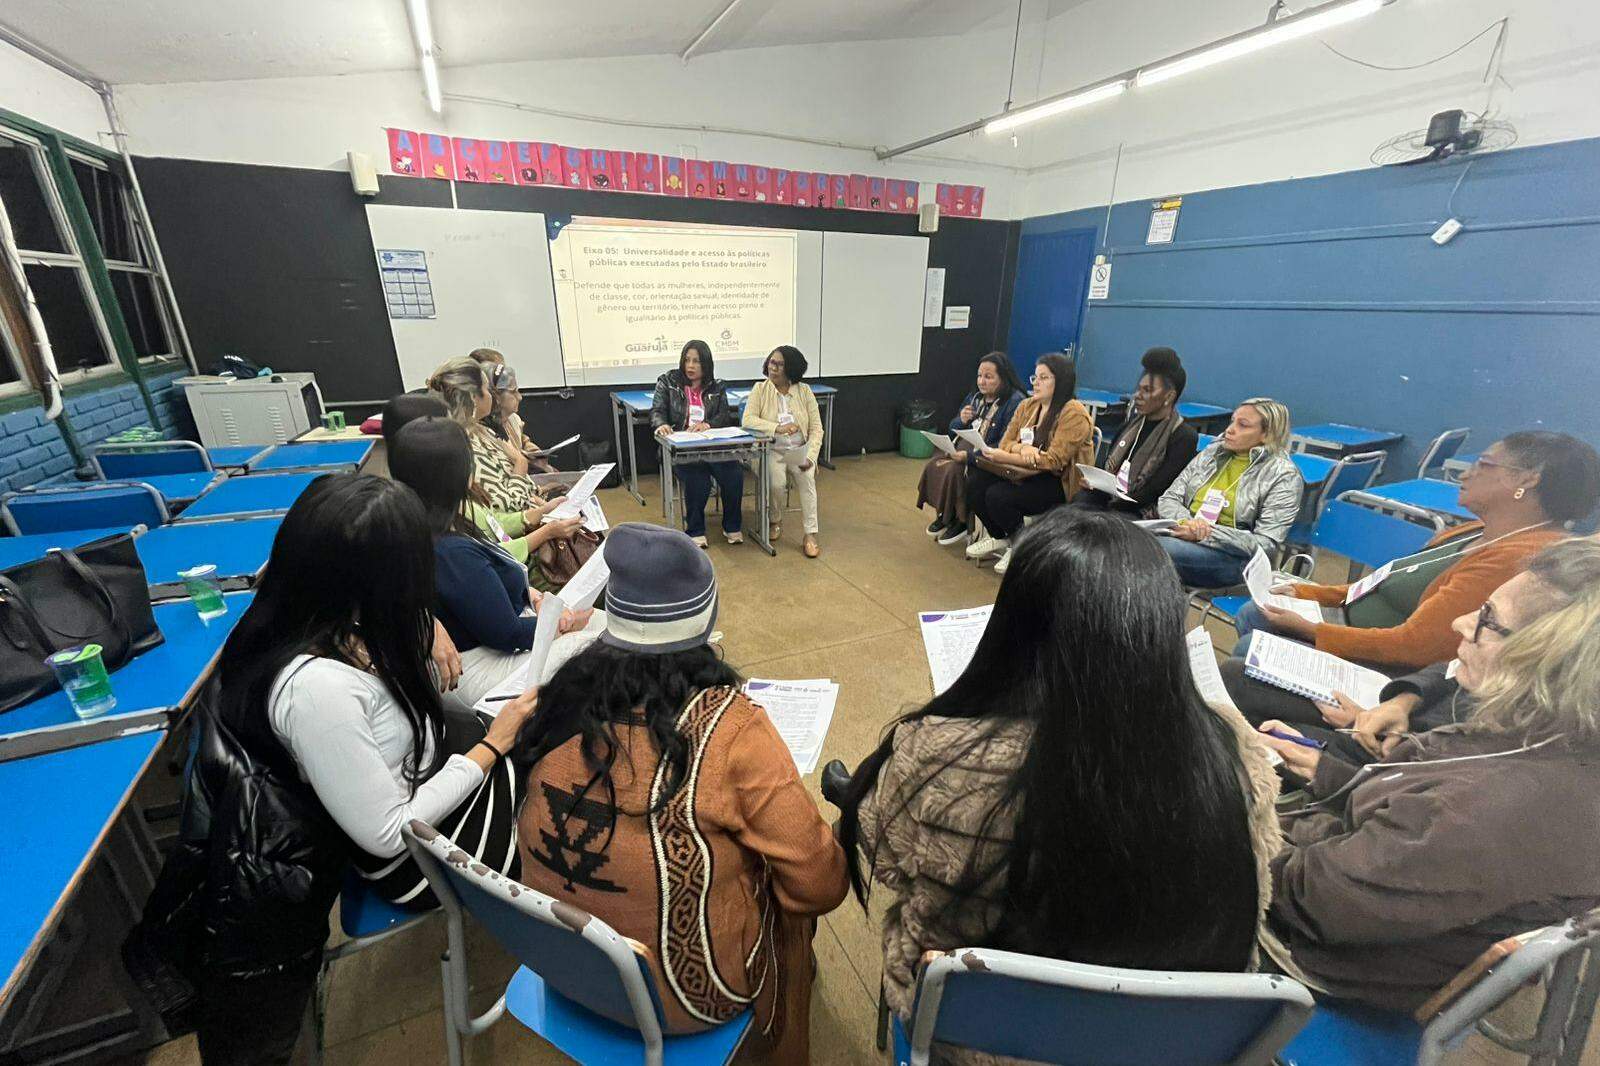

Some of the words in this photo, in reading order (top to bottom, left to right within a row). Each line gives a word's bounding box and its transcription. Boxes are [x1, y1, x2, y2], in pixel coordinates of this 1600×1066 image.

[583, 246, 603, 255] Eixo
[605, 247, 619, 255] 05:
[623, 247, 690, 257] Universalidade
[698, 249, 725, 258] acesso
[737, 248, 770, 259] políticas
[589, 258, 628, 269] públicas
[630, 259, 680, 267] executadas
[681, 260, 700, 269] pelo
[701, 260, 729, 268] Estado
[730, 260, 767, 269] brasileiro
[573, 281, 611, 290] Defende
[613, 282, 630, 292] que
[632, 281, 655, 290] todas
[667, 282, 706, 290] mulheres,
[707, 281, 780, 290] independentemente
[589, 292, 601, 301] de
[602, 292, 631, 301] classe,
[632, 294, 648, 302] cor,
[650, 292, 691, 302] orientação
[721, 291, 759, 300] identidade
[760, 291, 770, 299] de
[597, 303, 627, 314] gênero
[629, 304, 641, 312] ou
[642, 303, 680, 312] território,
[681, 302, 711, 311] tenham
[712, 302, 737, 310] acesso
[738, 301, 759, 311] pleno
[625, 313, 666, 324] igualitário
[679, 312, 710, 323] políticas
[711, 311, 742, 321] públicas.
[624, 336, 668, 353] Guarujá
